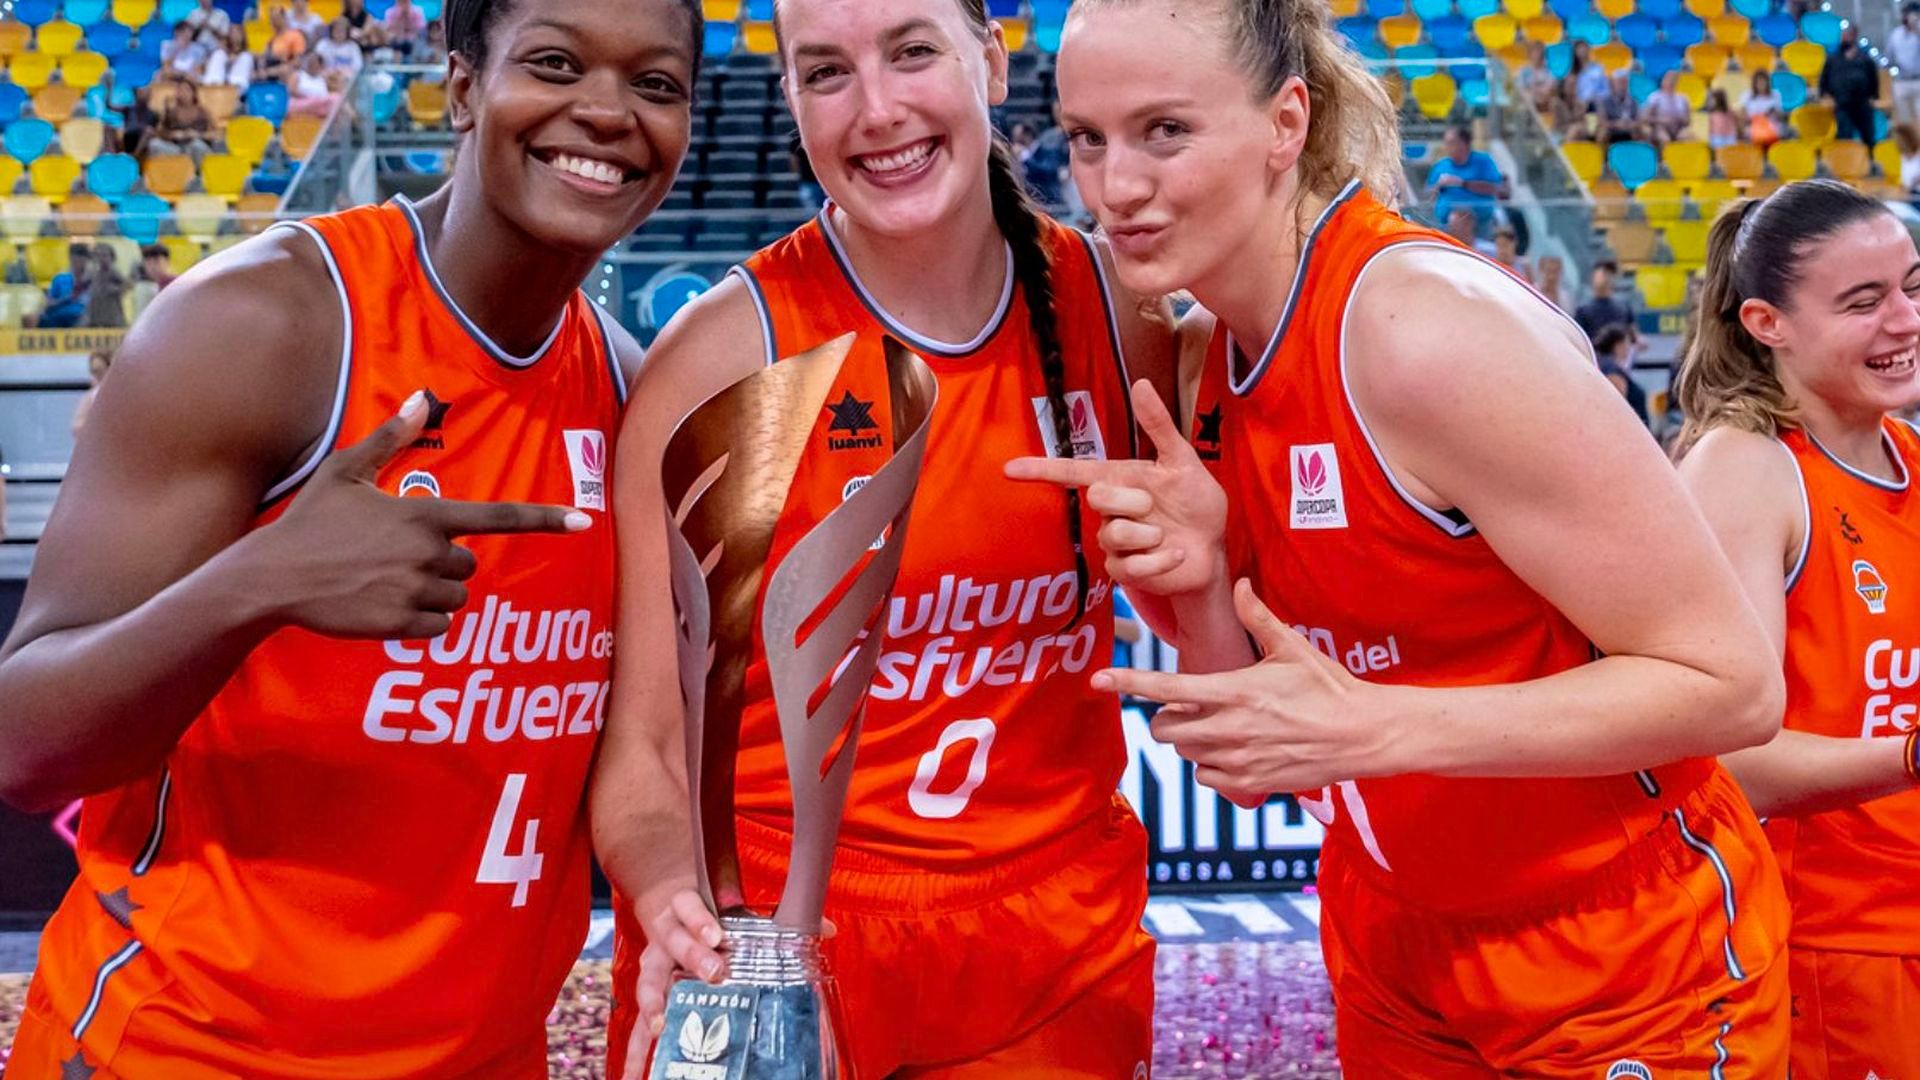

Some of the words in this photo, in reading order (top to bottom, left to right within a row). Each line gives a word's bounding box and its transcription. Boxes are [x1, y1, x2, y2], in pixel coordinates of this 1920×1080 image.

[886, 571, 1079, 640] ultura
[868, 623, 1097, 702] sfuerzo
[1346, 634, 1401, 675] del
[907, 717, 997, 819] 0
[475, 773, 545, 908] 4
[1147, 860, 1234, 883] DESA
[676, 991, 752, 1010] CAMPEÓN
